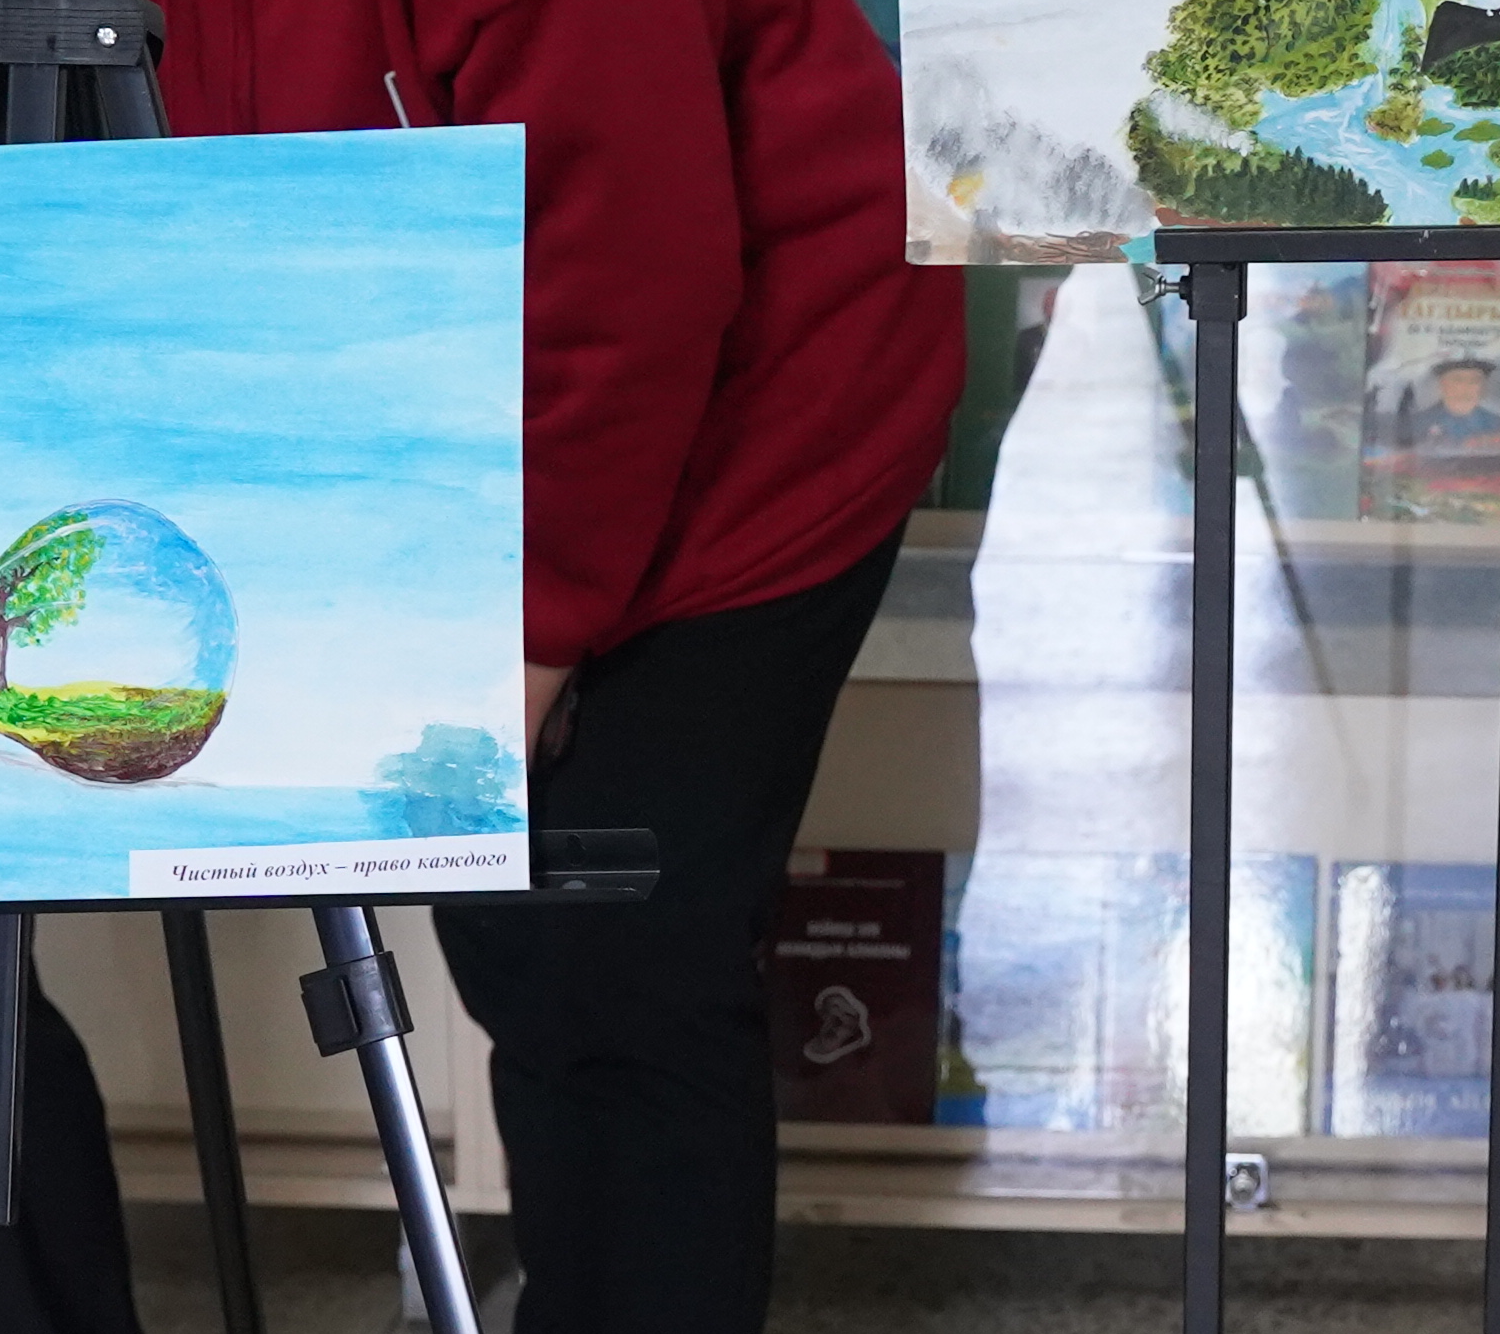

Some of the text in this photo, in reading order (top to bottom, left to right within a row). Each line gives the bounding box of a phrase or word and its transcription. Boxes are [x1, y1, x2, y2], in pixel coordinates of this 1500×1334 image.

[172, 860, 258, 883] Чистый
[264, 858, 330, 881] воздух
[353, 856, 411, 876] право
[417, 849, 508, 871] каждого
